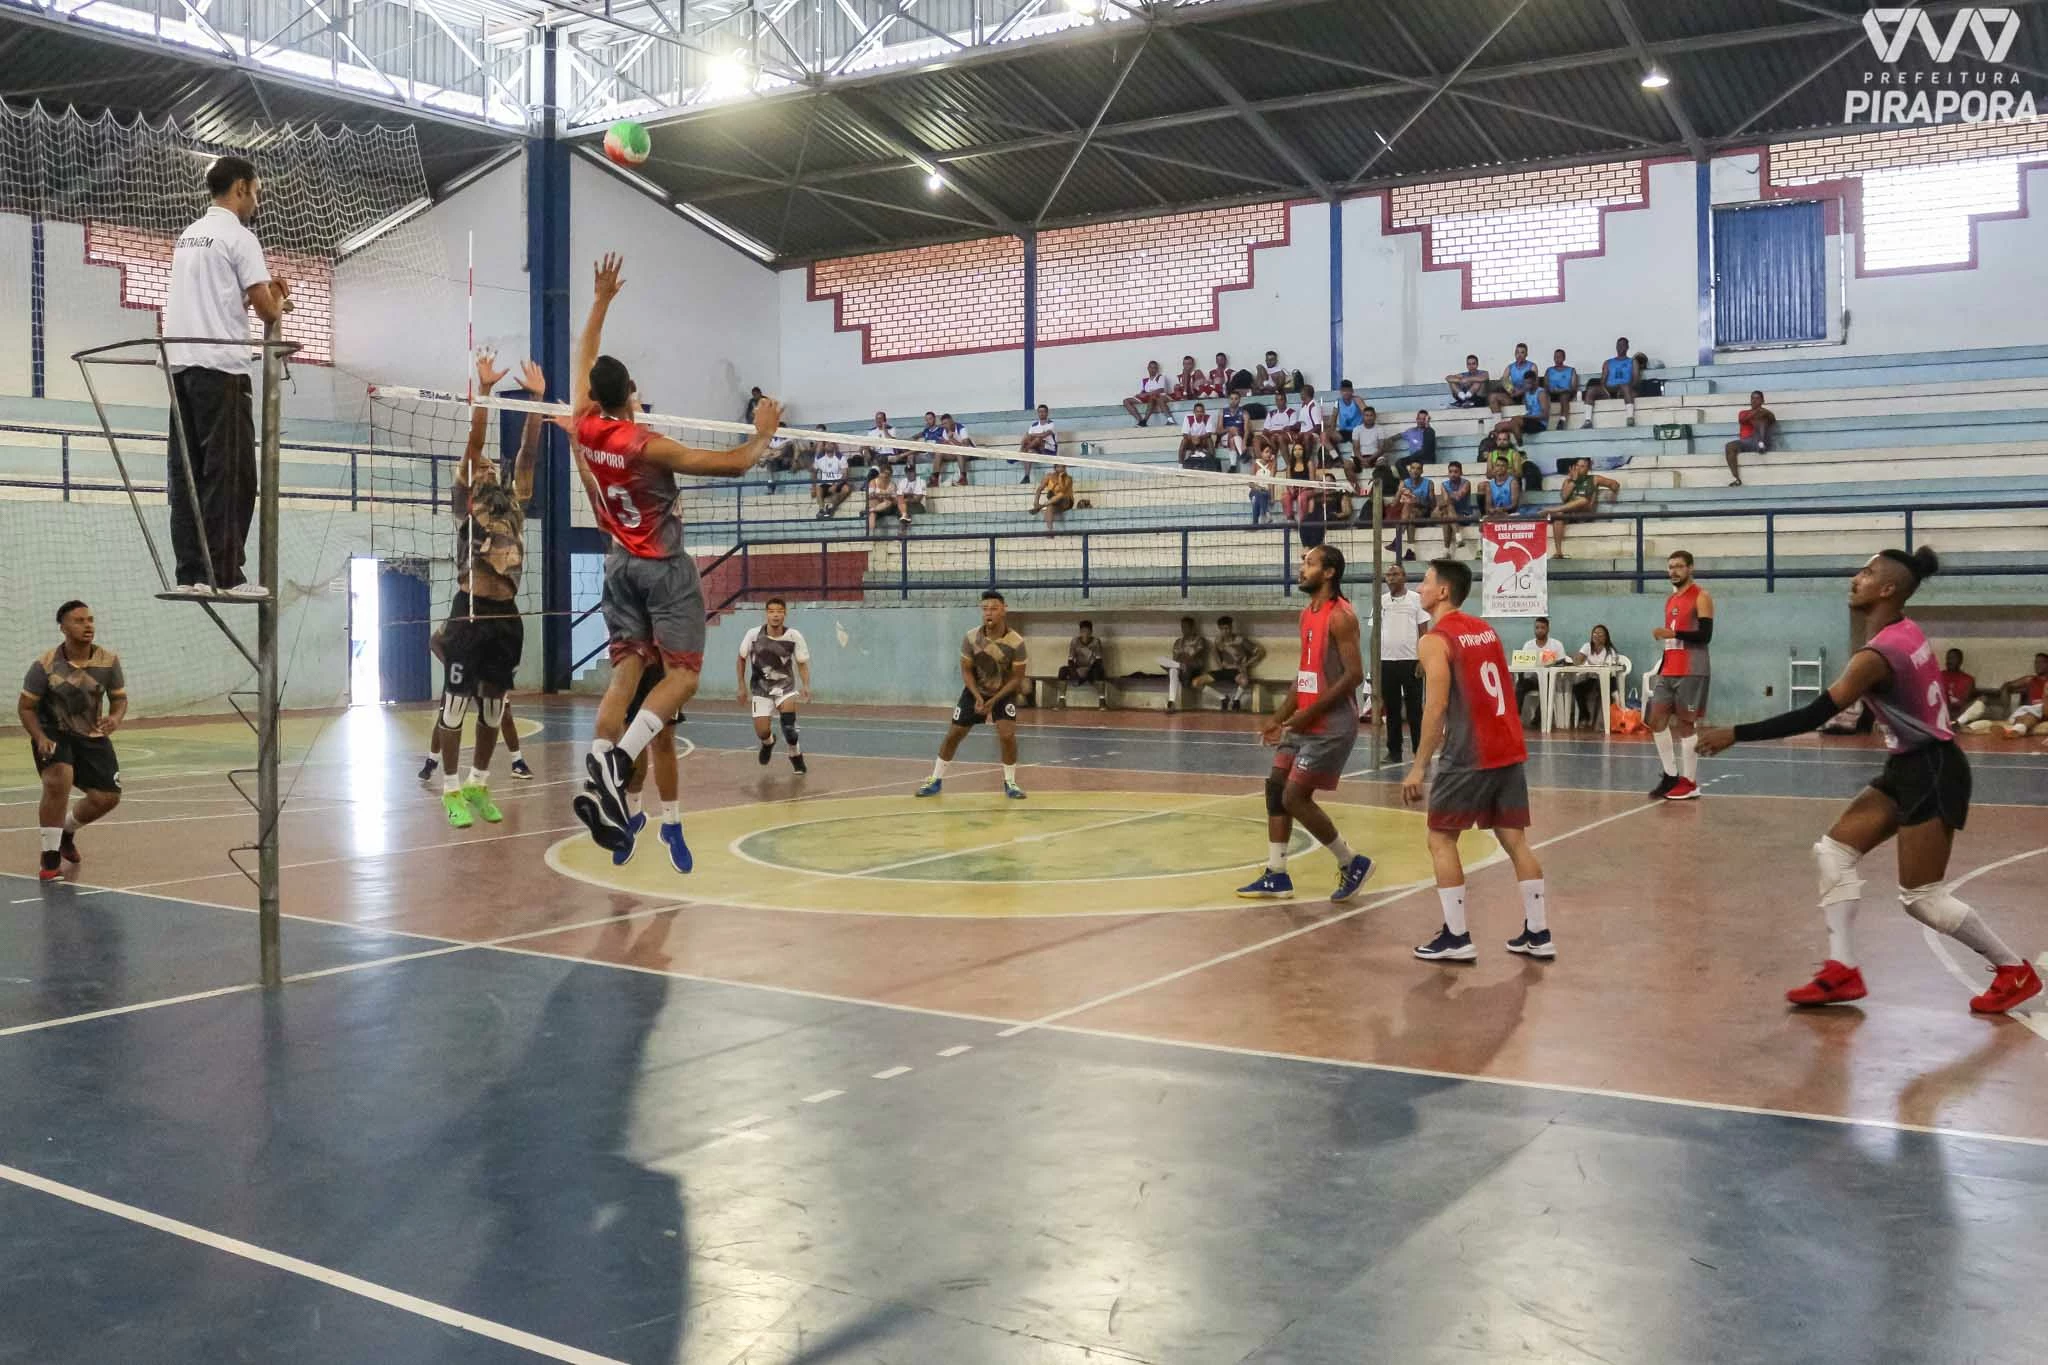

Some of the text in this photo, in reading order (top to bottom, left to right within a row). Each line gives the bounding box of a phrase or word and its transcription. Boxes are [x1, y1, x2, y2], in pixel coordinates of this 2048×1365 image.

[607, 486, 641, 528] 3
[450, 663, 464, 685] 6
[1480, 661, 1506, 717] 9
